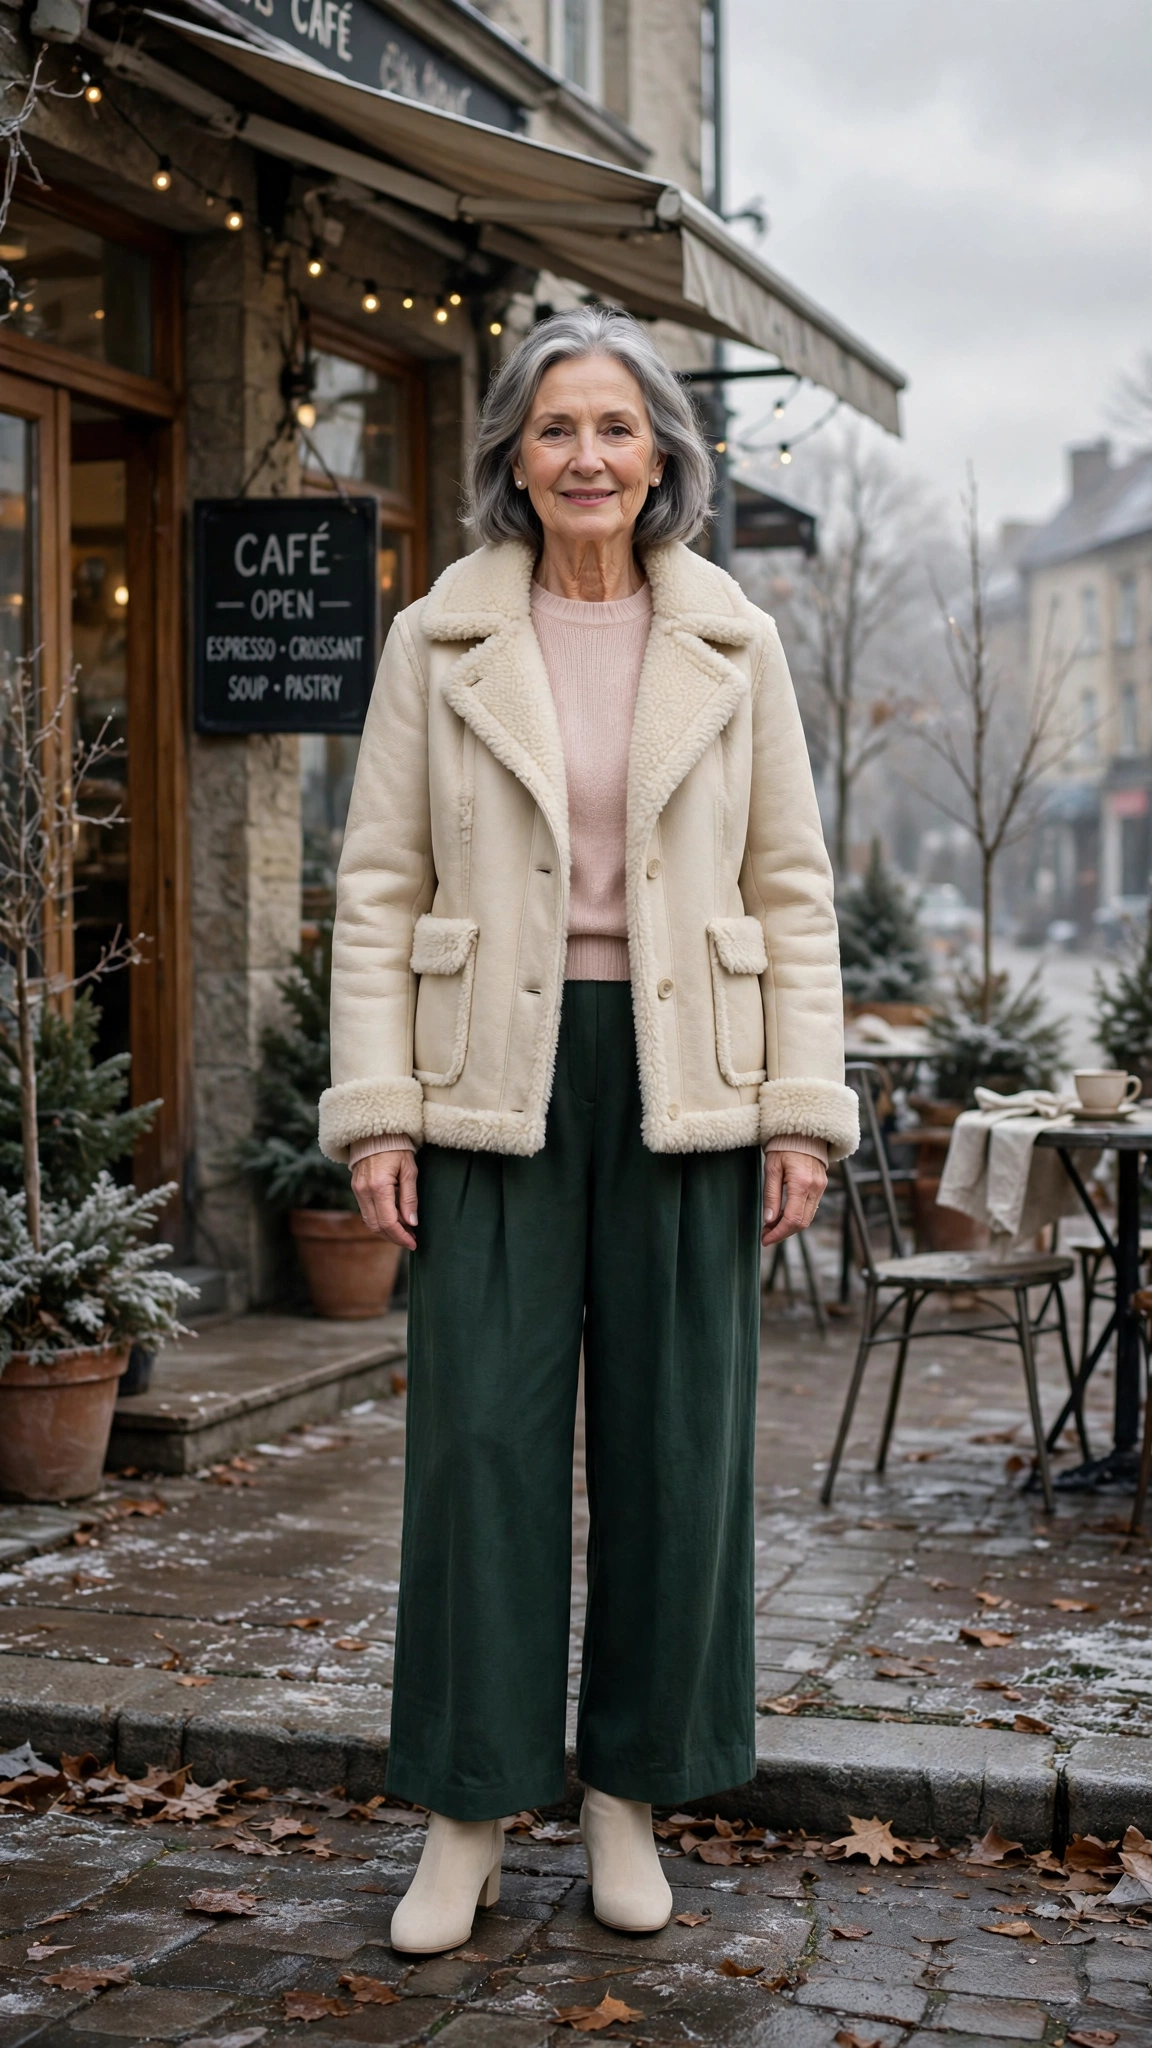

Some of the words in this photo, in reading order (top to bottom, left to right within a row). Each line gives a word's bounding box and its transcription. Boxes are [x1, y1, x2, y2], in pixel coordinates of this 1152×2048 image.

[291, 0, 353, 62] CAFÉ
[234, 521, 331, 577] CAFÉ
[250, 588, 315, 621] OPEN
[206, 636, 276, 662] ESPRESSO
[288, 635, 364, 662] CROISSANT
[228, 674, 269, 702] SOUP
[284, 674, 343, 702] PASTRY
